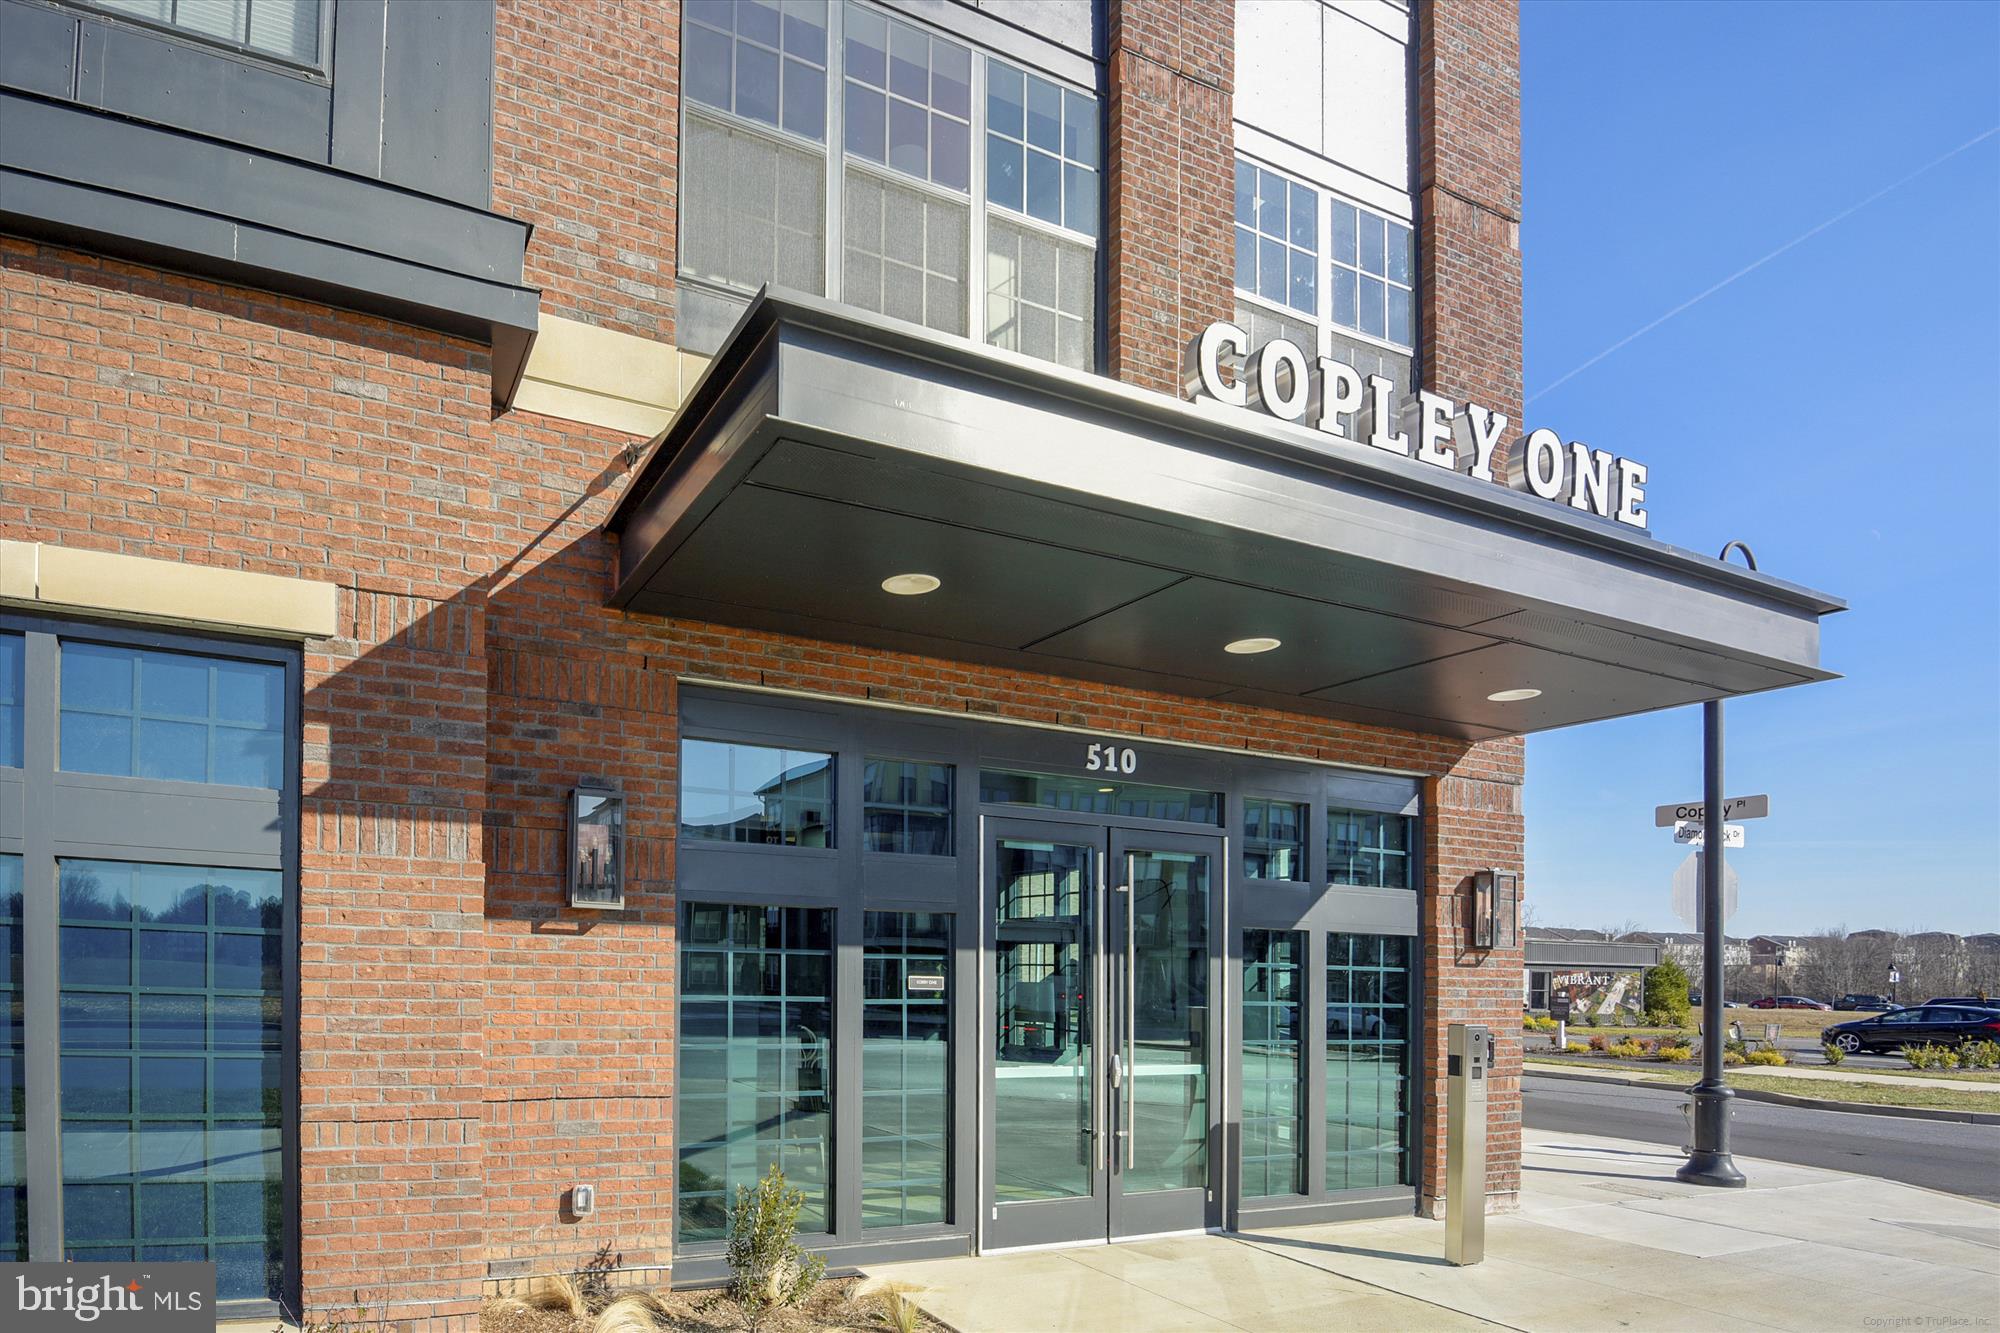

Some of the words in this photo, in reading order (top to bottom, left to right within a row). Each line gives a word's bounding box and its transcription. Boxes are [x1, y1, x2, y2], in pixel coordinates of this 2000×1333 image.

[1196, 321, 1509, 483] COPLEY
[1524, 427, 1649, 530] ONE
[1085, 743, 1137, 774] 510
[1676, 804, 1732, 820] Copy
[1736, 800, 1746, 809] Pl
[1557, 975, 1610, 986] VIBRANT
